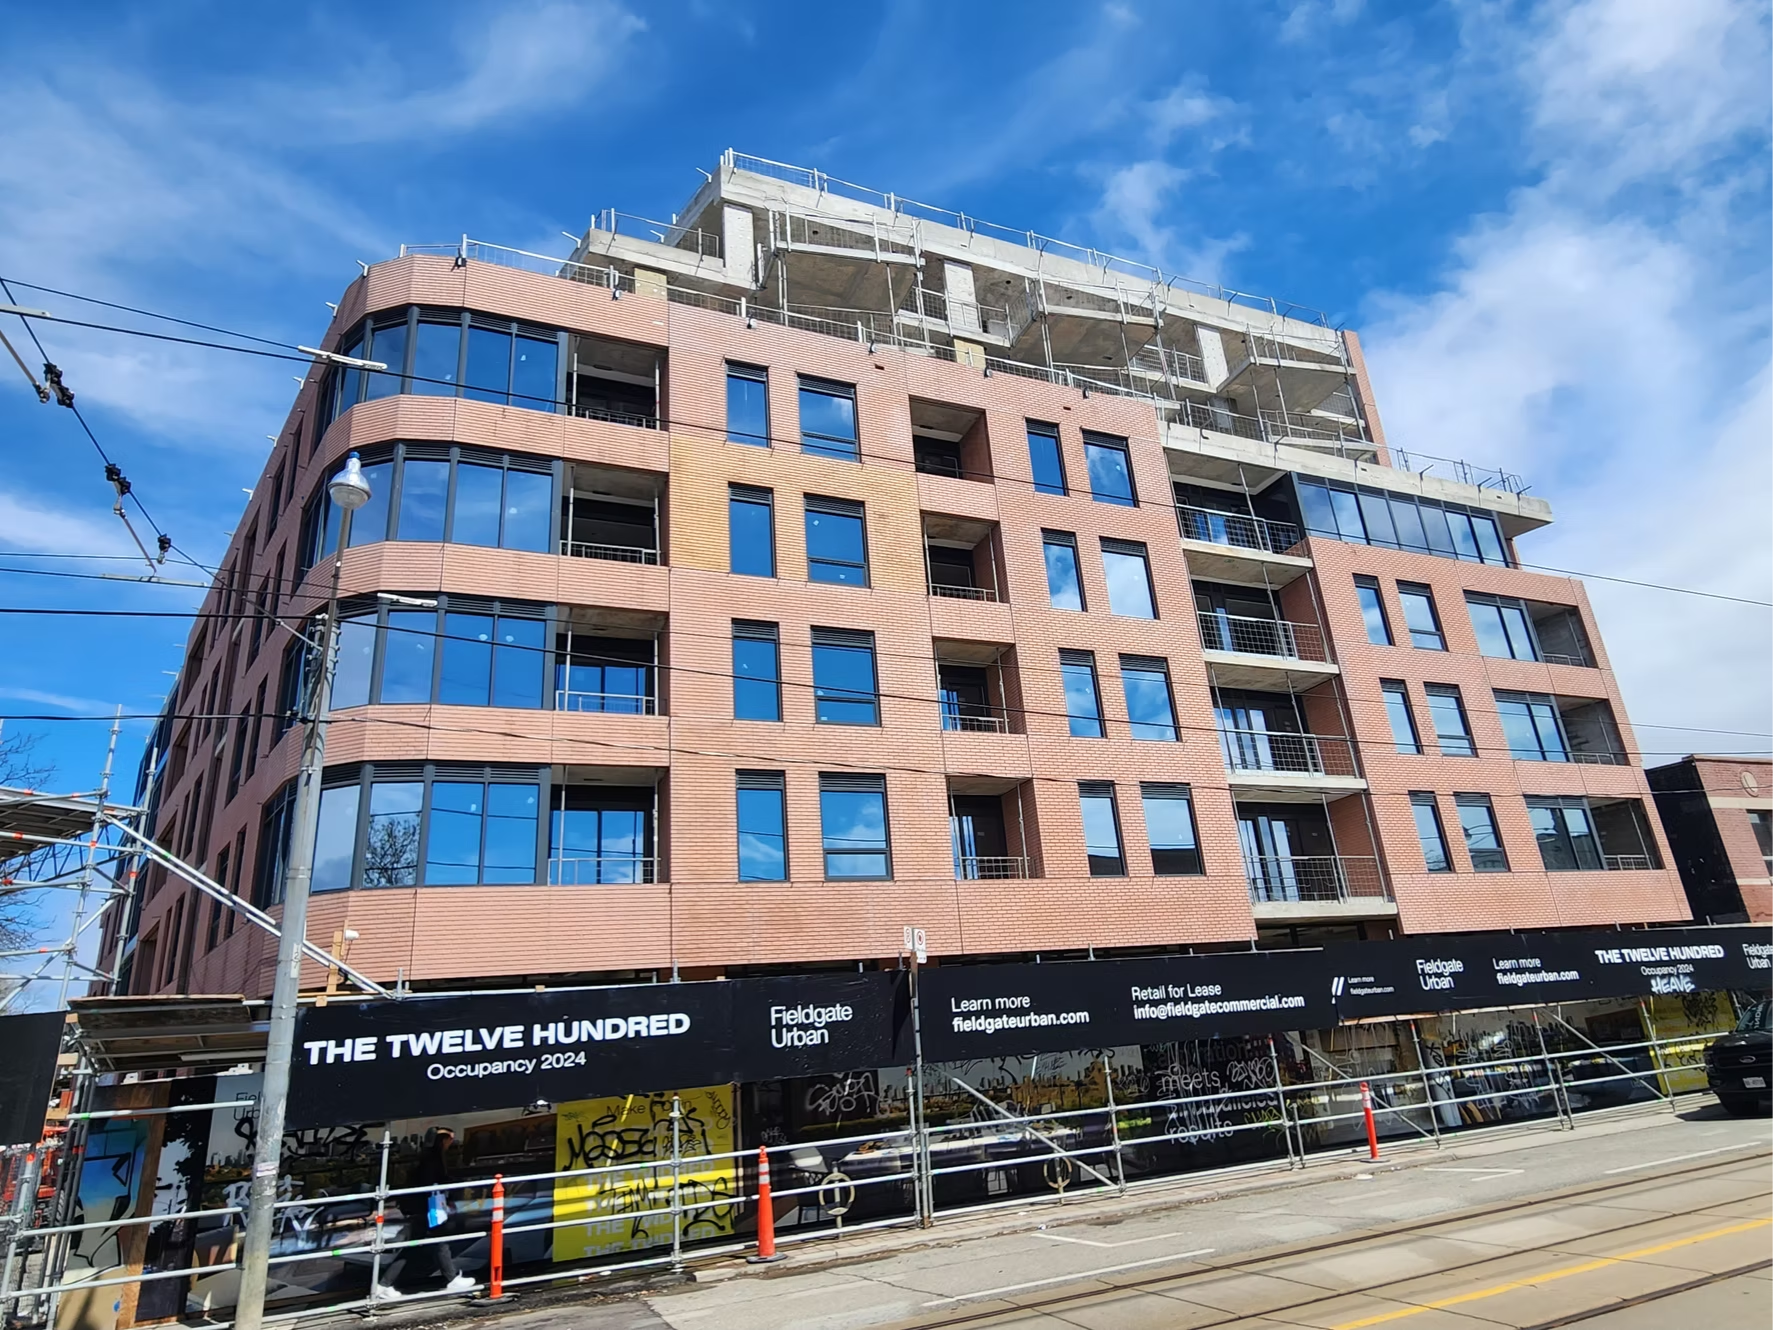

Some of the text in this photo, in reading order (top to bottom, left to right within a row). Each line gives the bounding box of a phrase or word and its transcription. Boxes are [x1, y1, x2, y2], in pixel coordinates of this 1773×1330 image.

[1595, 945, 1724, 964] THE TWELVE HUNDRED
[1742, 943, 1772, 958] Fieldgat
[1416, 958, 1464, 975] Fieldgate
[1493, 957, 1542, 970] Learn more
[1640, 963, 1695, 976] Occupancy 2024
[1746, 956, 1772, 969] Urban
[1419, 973, 1455, 990] Urban
[1495, 969, 1580, 986] fieldgateurban.com
[1131, 982, 1222, 1001] Retail for Lease
[951, 995, 1031, 1013] Learn more
[1132, 994, 1306, 1020] info@fieldgatecommercial.com
[770, 1002, 853, 1028] Fieldgate
[952, 1009, 1090, 1034] fieldgateurban.com
[303, 1013, 691, 1066] THE TWELVE HUNDRED
[771, 1024, 829, 1050] Urban
[426, 1050, 587, 1081] Occupancy 2024
[606, 1104, 646, 1116] Make
